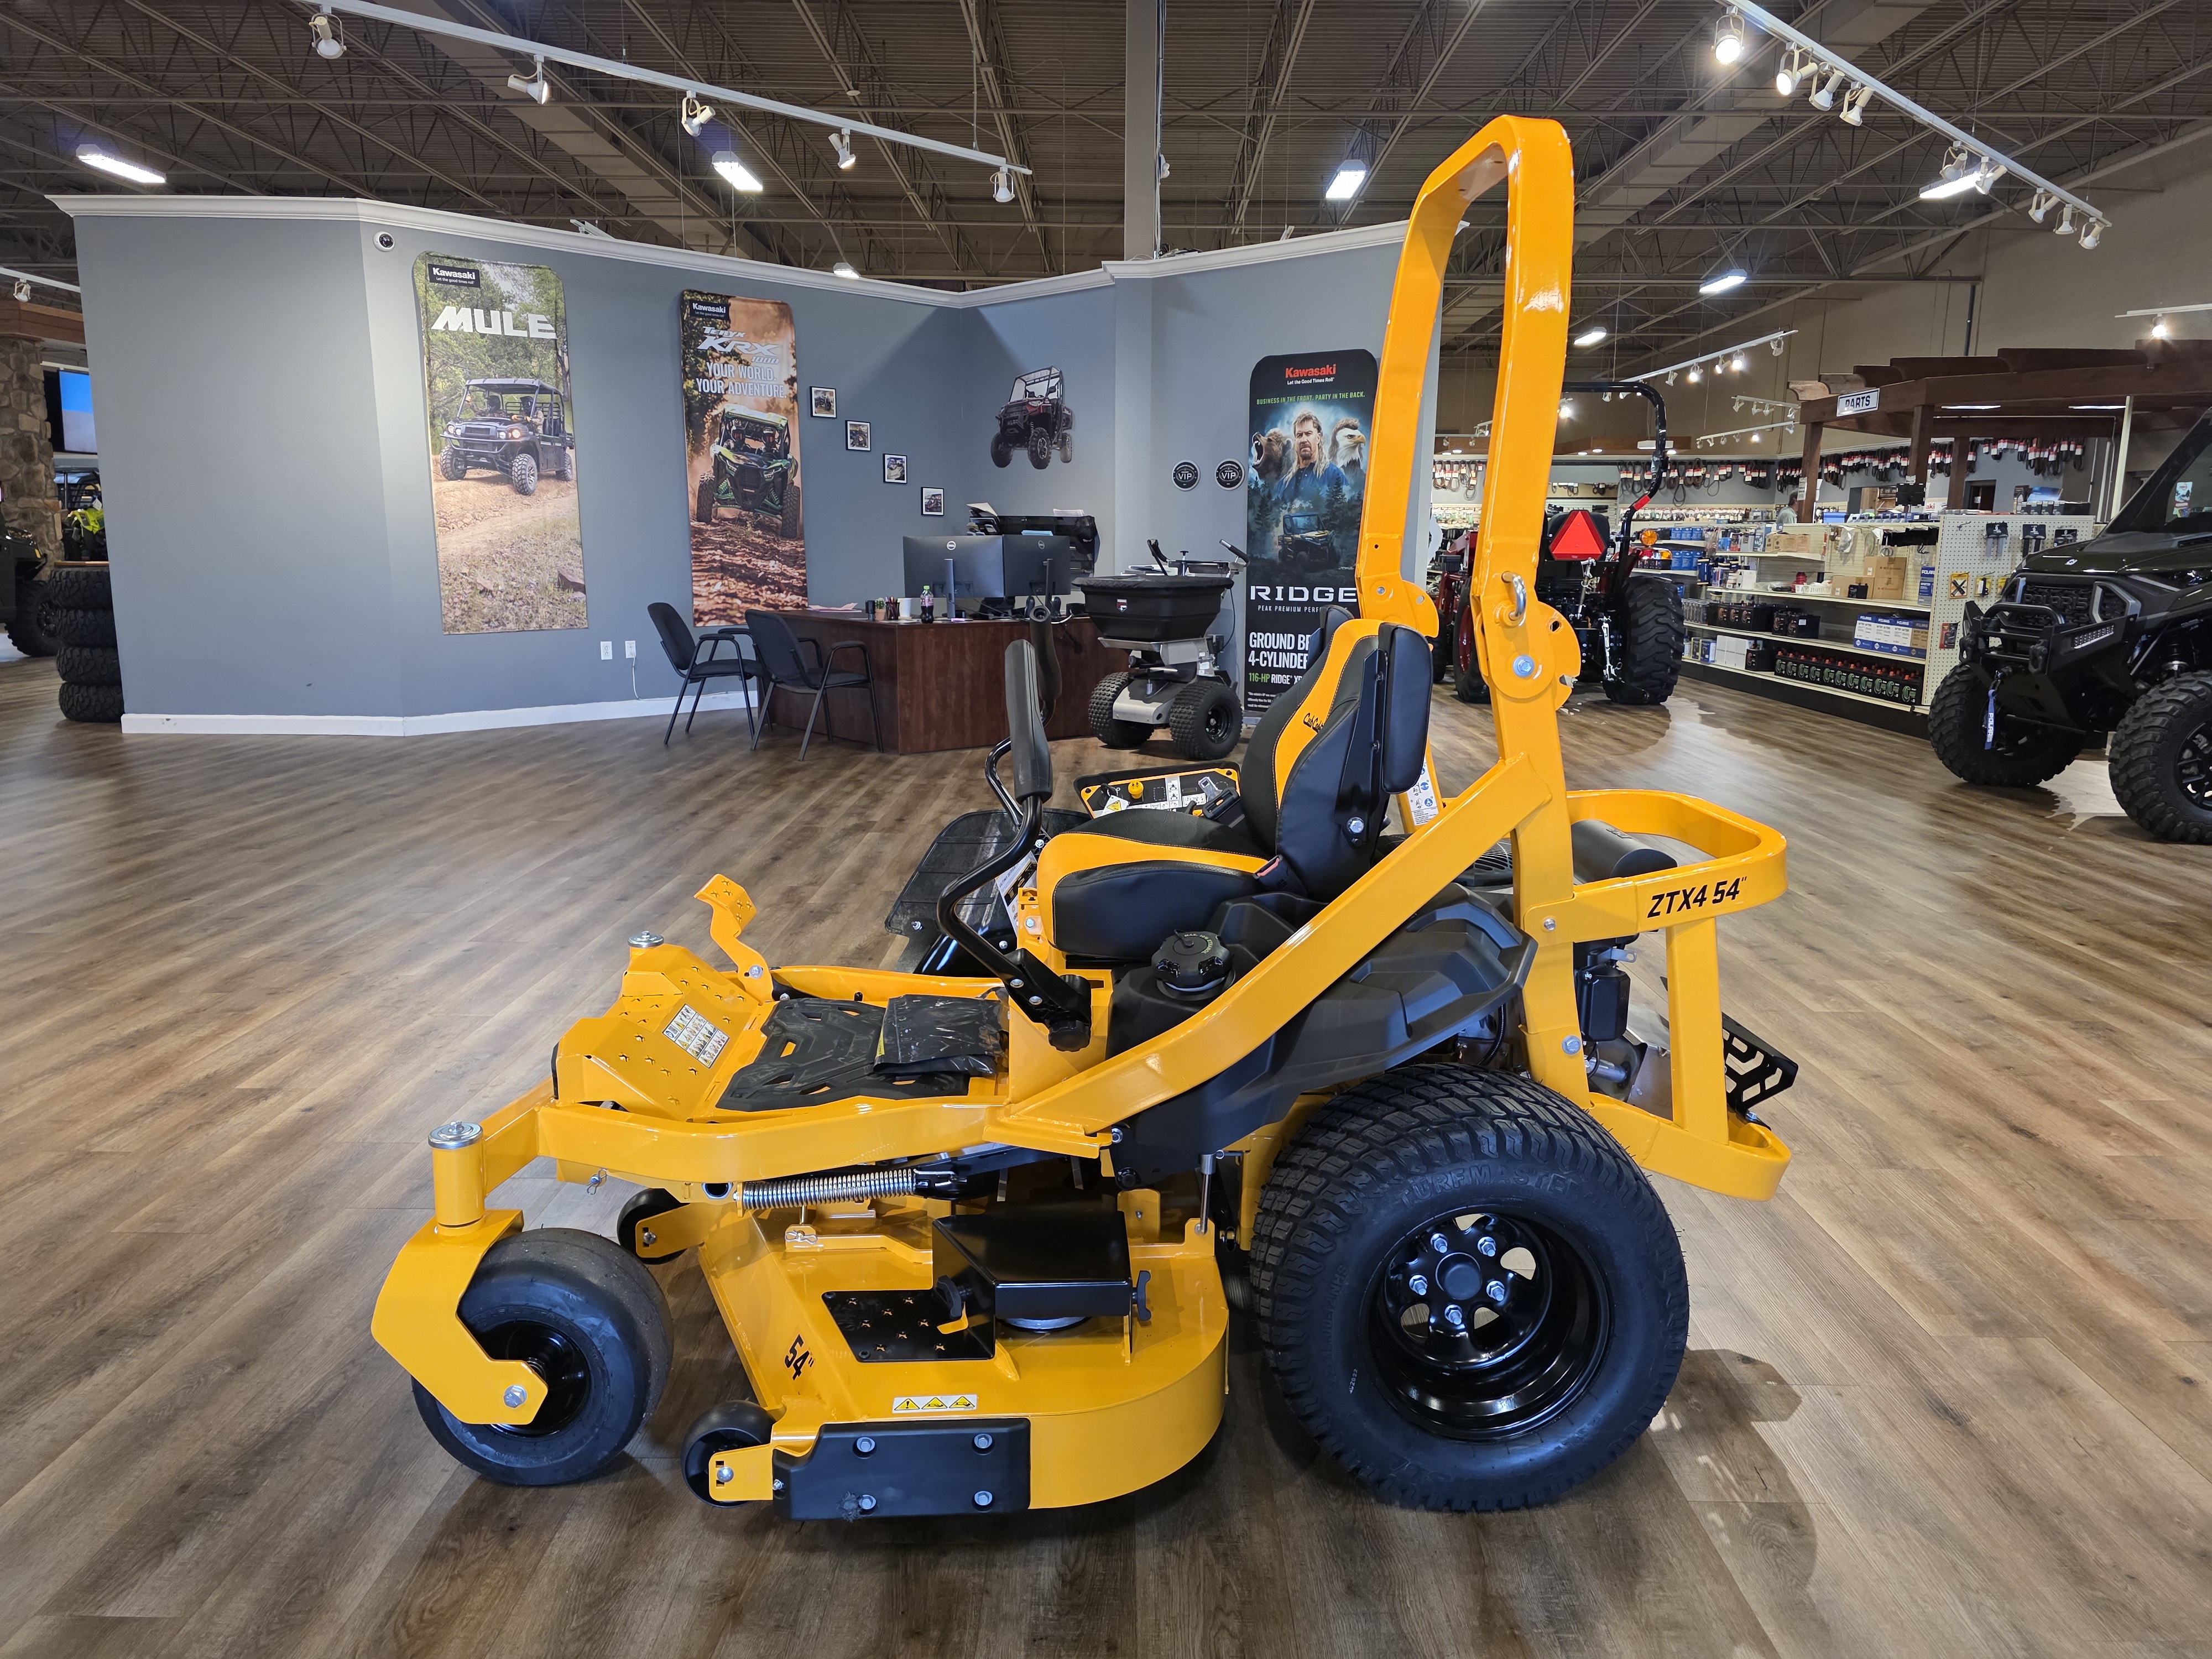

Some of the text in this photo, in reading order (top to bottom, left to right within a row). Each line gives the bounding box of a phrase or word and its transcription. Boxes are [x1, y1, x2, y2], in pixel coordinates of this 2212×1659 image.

[432, 267, 476, 280] Kawasaki
[692, 302, 726, 314] Kawasaki
[431, 306, 557, 340] MULE
[697, 335, 780, 357] KRX
[751, 356, 780, 364] 1000
[706, 362, 777, 382] YOUR WORLD.
[1285, 364, 1336, 378] Kawasaki
[696, 378, 787, 399] YOUR ADVENTURE.
[1845, 395, 1871, 409] PARTS
[1250, 585, 1357, 602] RIDGE
[1249, 632, 1295, 650] GROUND
[1249, 672, 1270, 682] 116-HP
[1647, 876, 1747, 919] ZTX4 54"
[1395, 1165, 1582, 1209] TURFMASTER
[784, 1334, 815, 1381] 54"
